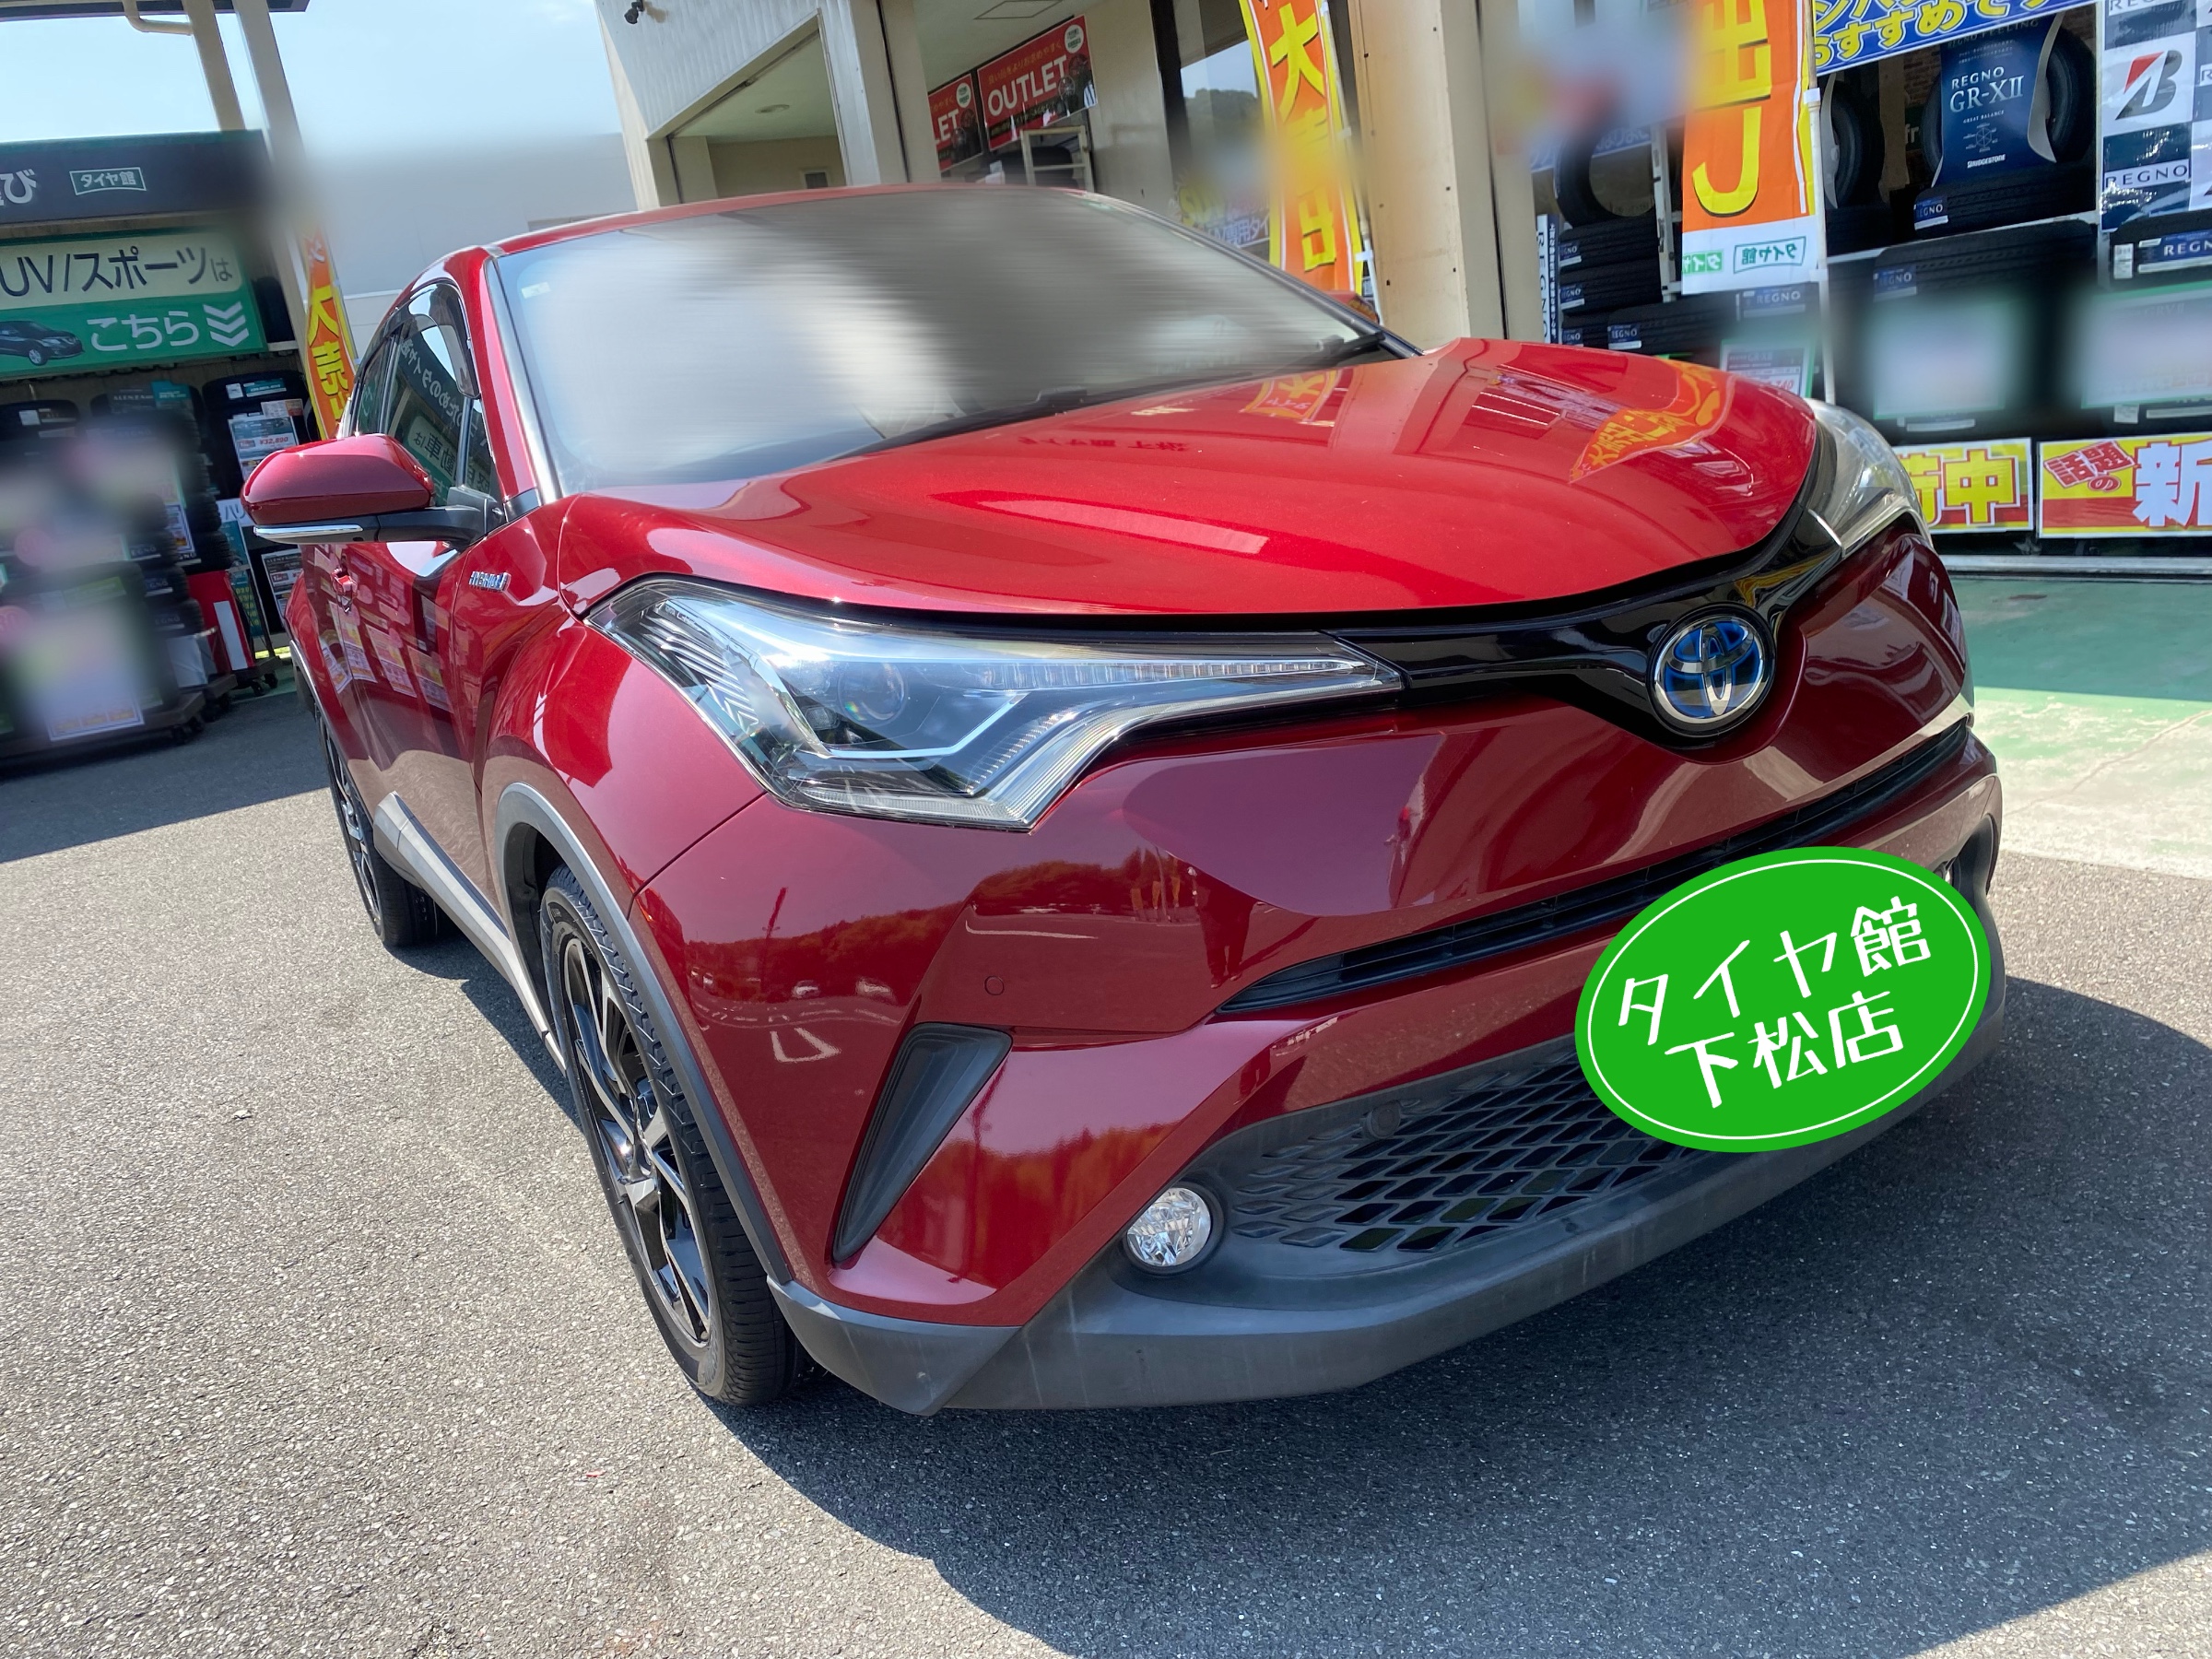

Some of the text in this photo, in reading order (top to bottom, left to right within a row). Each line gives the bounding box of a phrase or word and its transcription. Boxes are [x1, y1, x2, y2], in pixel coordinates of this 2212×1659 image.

[987, 54, 1067, 117] OUTLET
[1951, 65, 2006, 90] REGNO
[1963, 110, 2005, 124] GREAT BALANCE
[1967, 153, 2006, 169] BRIDGESTONE
[80, 171, 137, 188] タイヤ館
[2105, 164, 2188, 186] REGNO
[0, 169, 37, 206] び
[1757, 290, 1801, 304] REGNO
[87, 310, 200, 352] こちら
